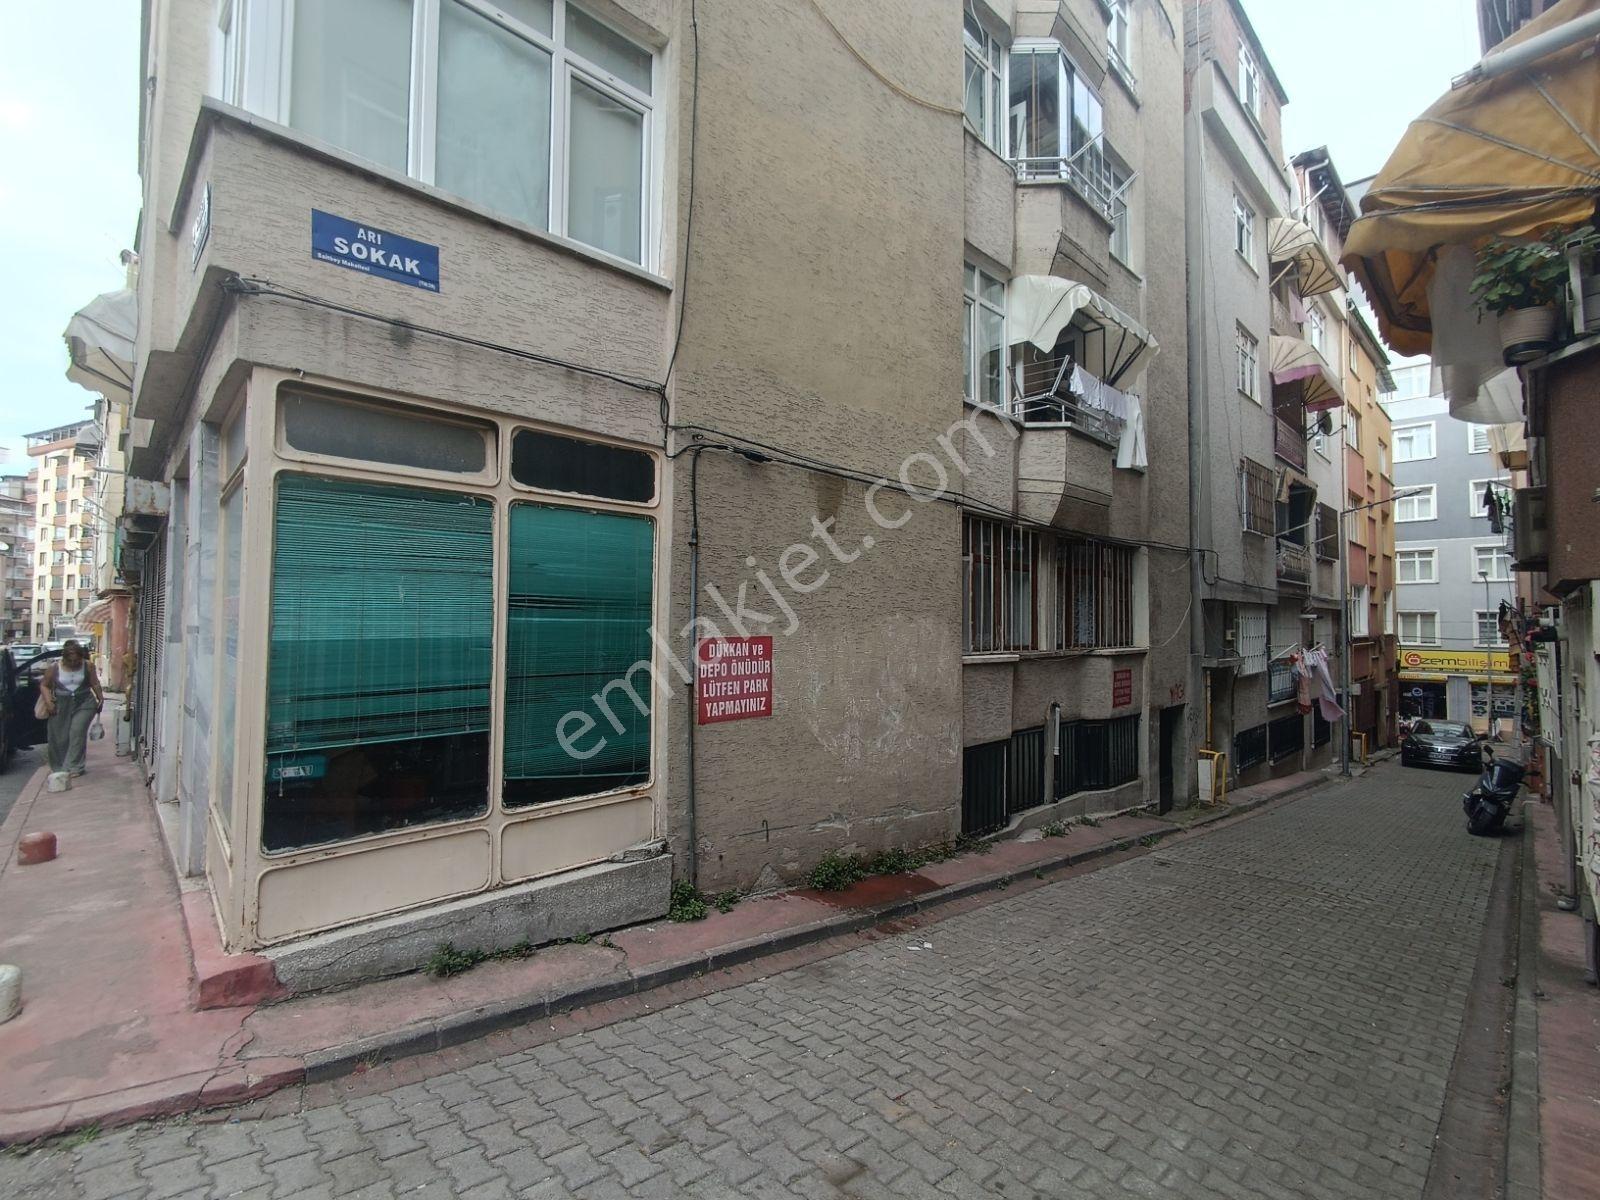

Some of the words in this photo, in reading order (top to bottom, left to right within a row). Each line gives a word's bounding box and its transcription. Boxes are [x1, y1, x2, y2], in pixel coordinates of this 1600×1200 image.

[357, 228, 382, 245] ARI
[333, 237, 420, 275] SOKAK
[341, 259, 370, 272] Mahallesi
[708, 641, 749, 658] DÜKKAN
[752, 644, 763, 656] ve
[700, 662, 727, 678] DEPO
[731, 657, 771, 676] ÖNÜDÜR
[703, 680, 740, 698] LÜTFEN
[743, 678, 769, 694] PARK
[705, 697, 766, 717] YAPMAYINIZ
